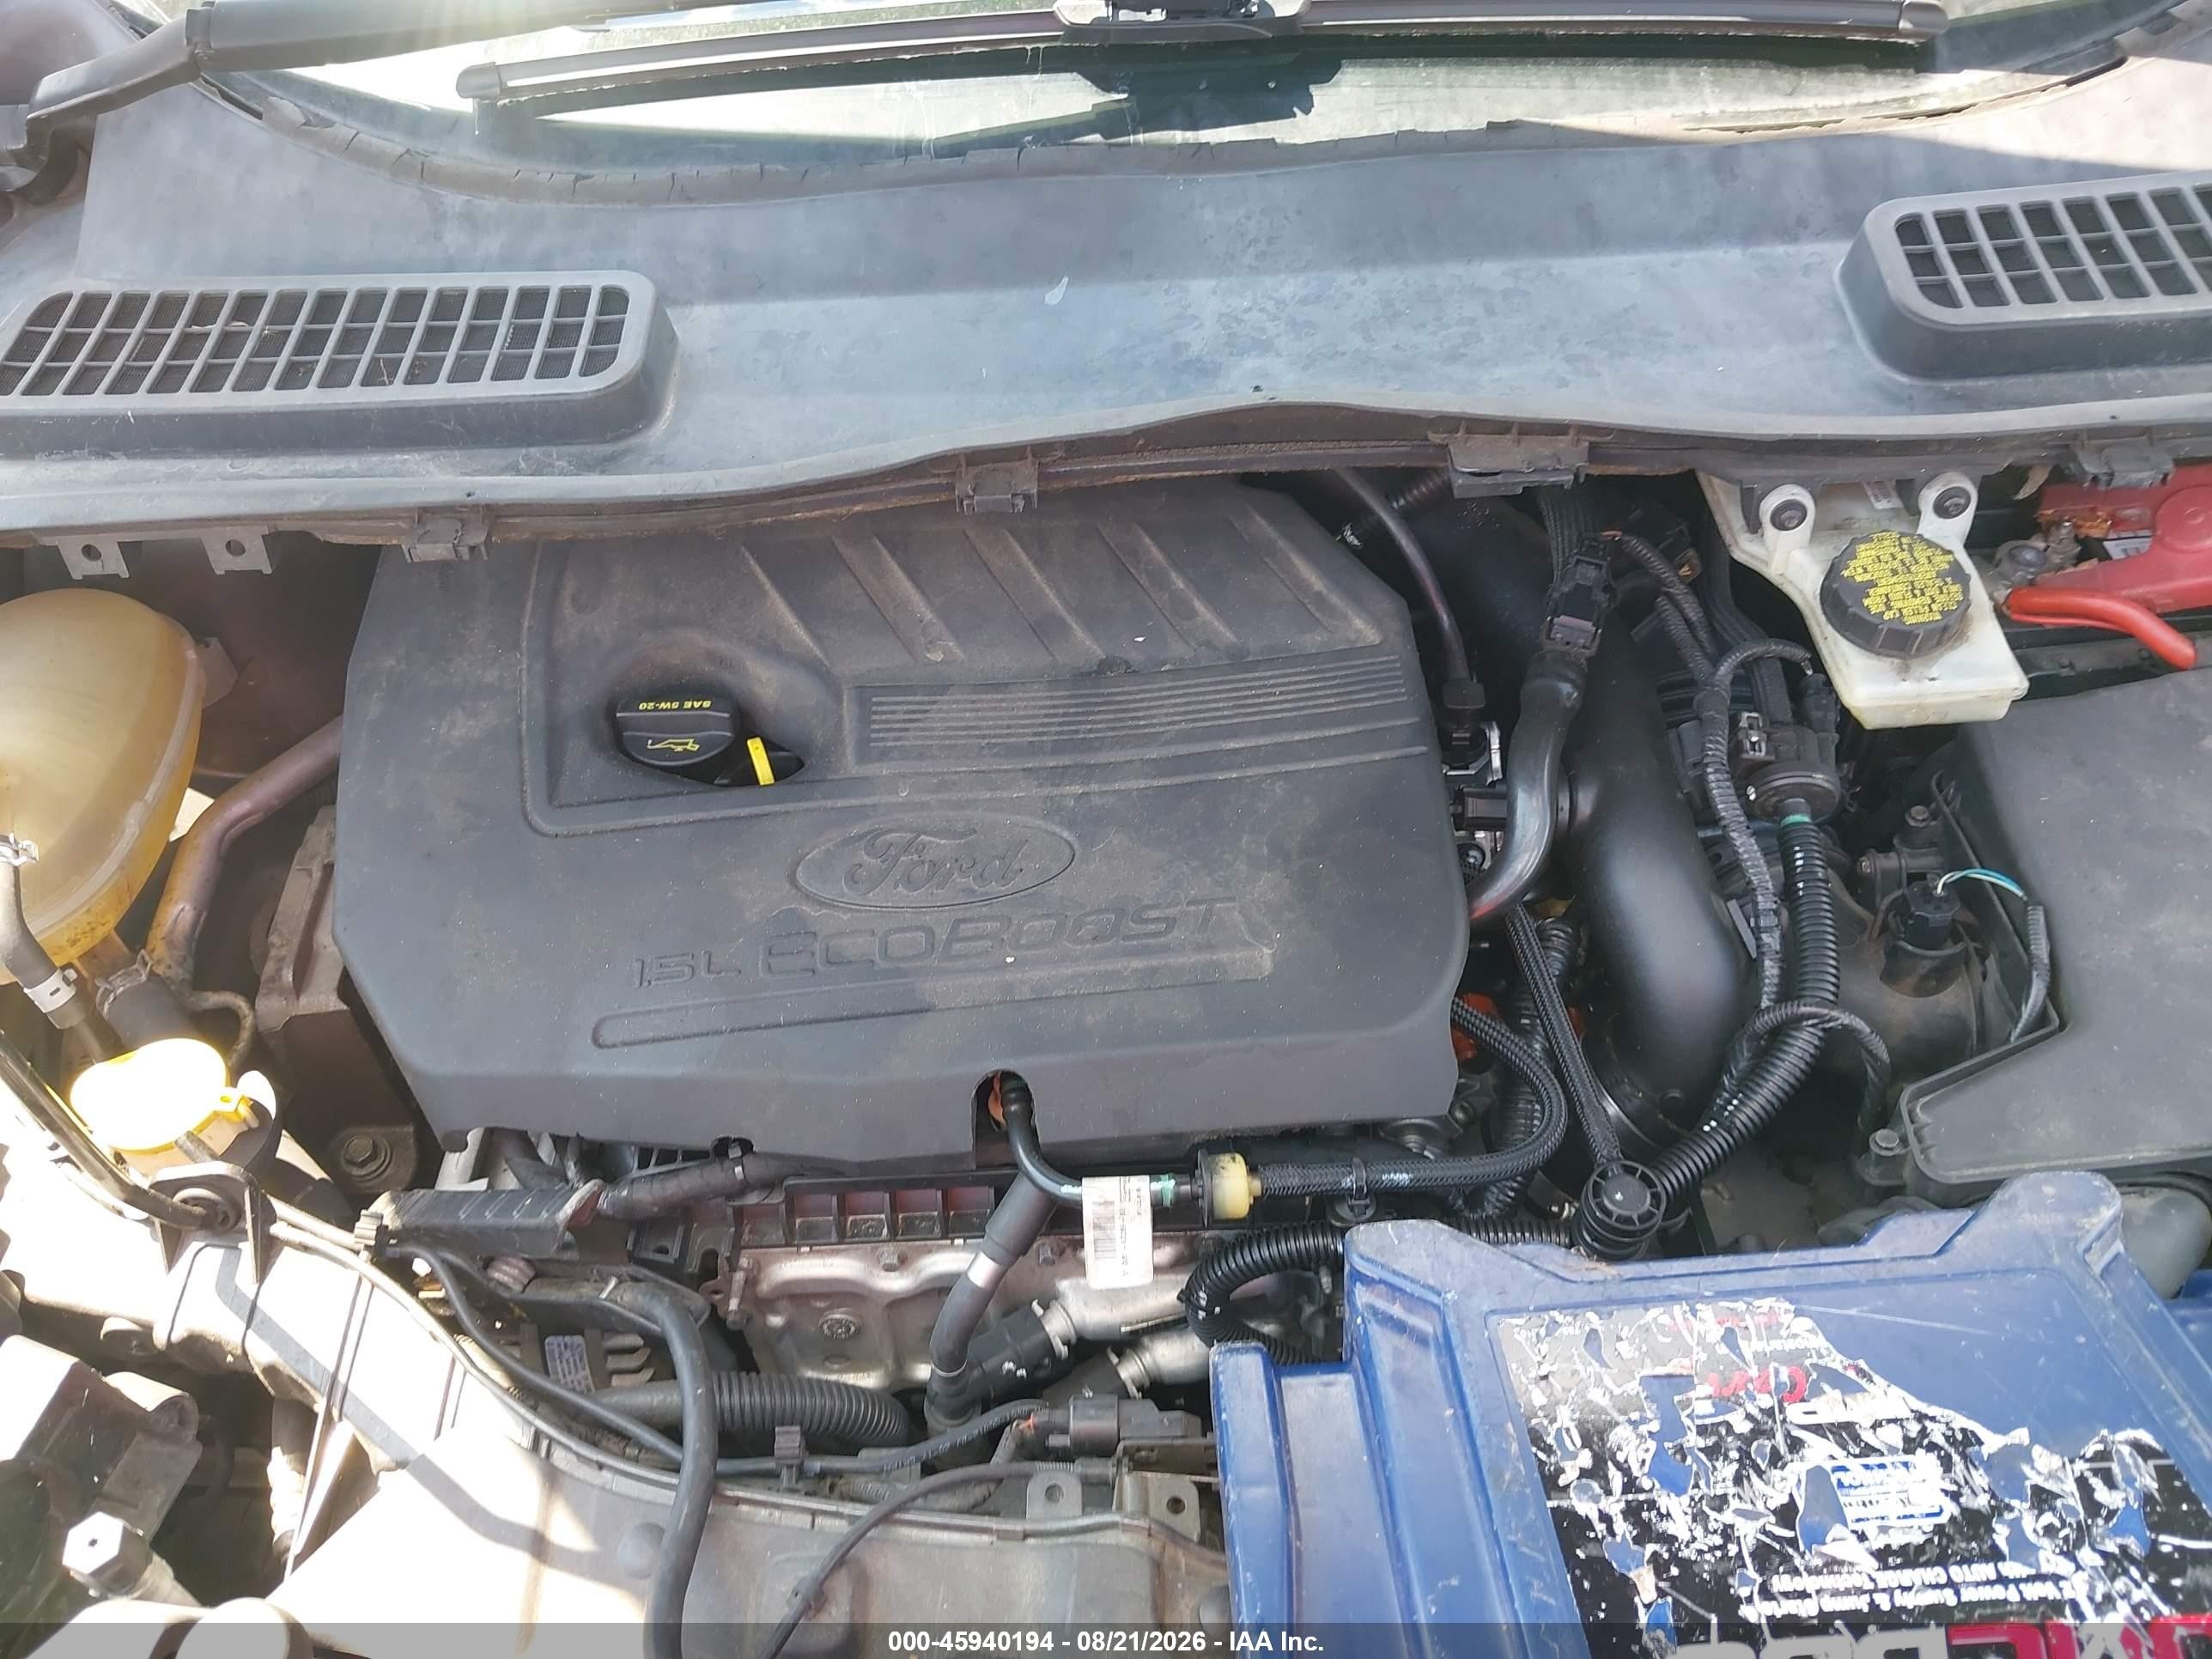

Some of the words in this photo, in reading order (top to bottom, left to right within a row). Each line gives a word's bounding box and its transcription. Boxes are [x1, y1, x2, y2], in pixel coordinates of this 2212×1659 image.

[638, 701, 679, 710] 5W-20
[683, 700, 712, 708] SAE
[842, 829, 1029, 896] Ford
[1771, 1571, 1875, 1592] Technology
[1875, 1566, 1948, 1586] CHARGE
[1948, 1562, 1997, 1583] AUTO
[1820, 1592, 1870, 1613] Jump
[1874, 1592, 1891, 1611] &
[1894, 1586, 1958, 1607] Supply
[1960, 1584, 2021, 1602] Power
